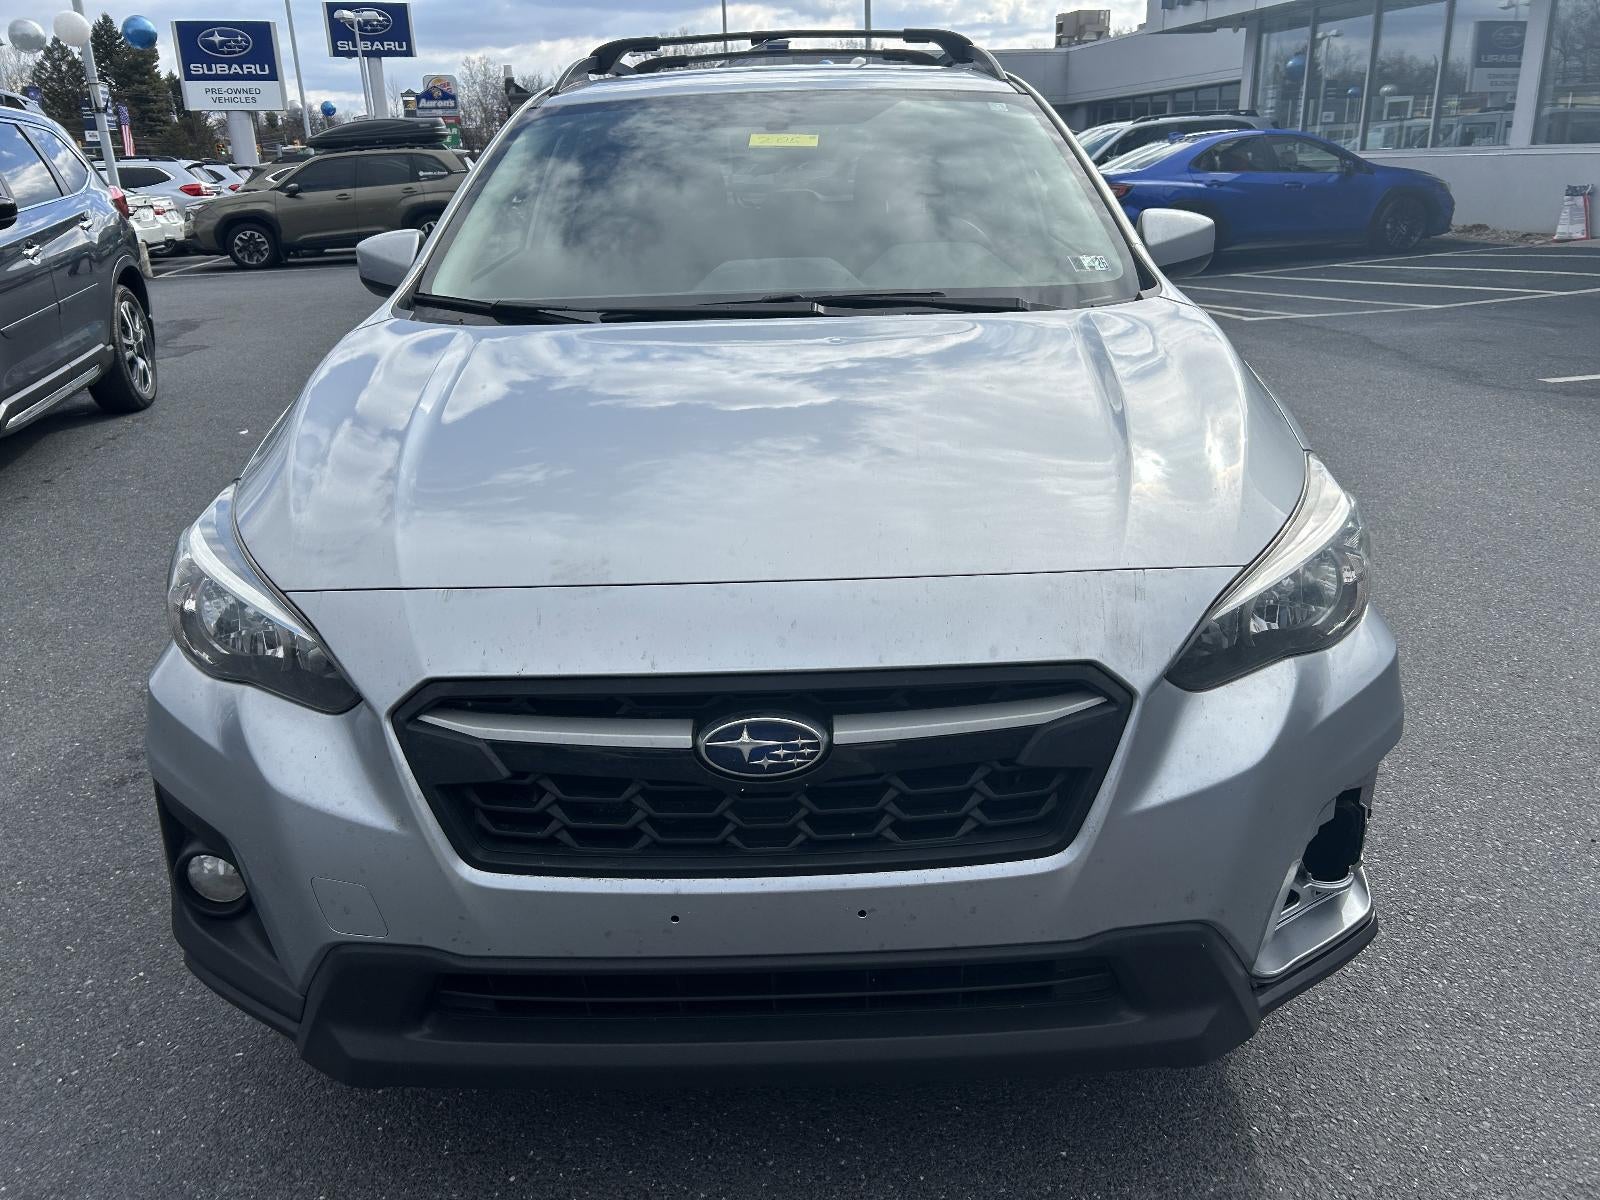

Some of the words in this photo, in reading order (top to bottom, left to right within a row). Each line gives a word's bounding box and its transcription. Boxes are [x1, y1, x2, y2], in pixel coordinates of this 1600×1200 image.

[337, 40, 407, 51] SUBARU
[189, 63, 270, 75] SUBARU
[205, 87, 261, 95] PRE-OWNED
[211, 96, 257, 104] VEHICLES
